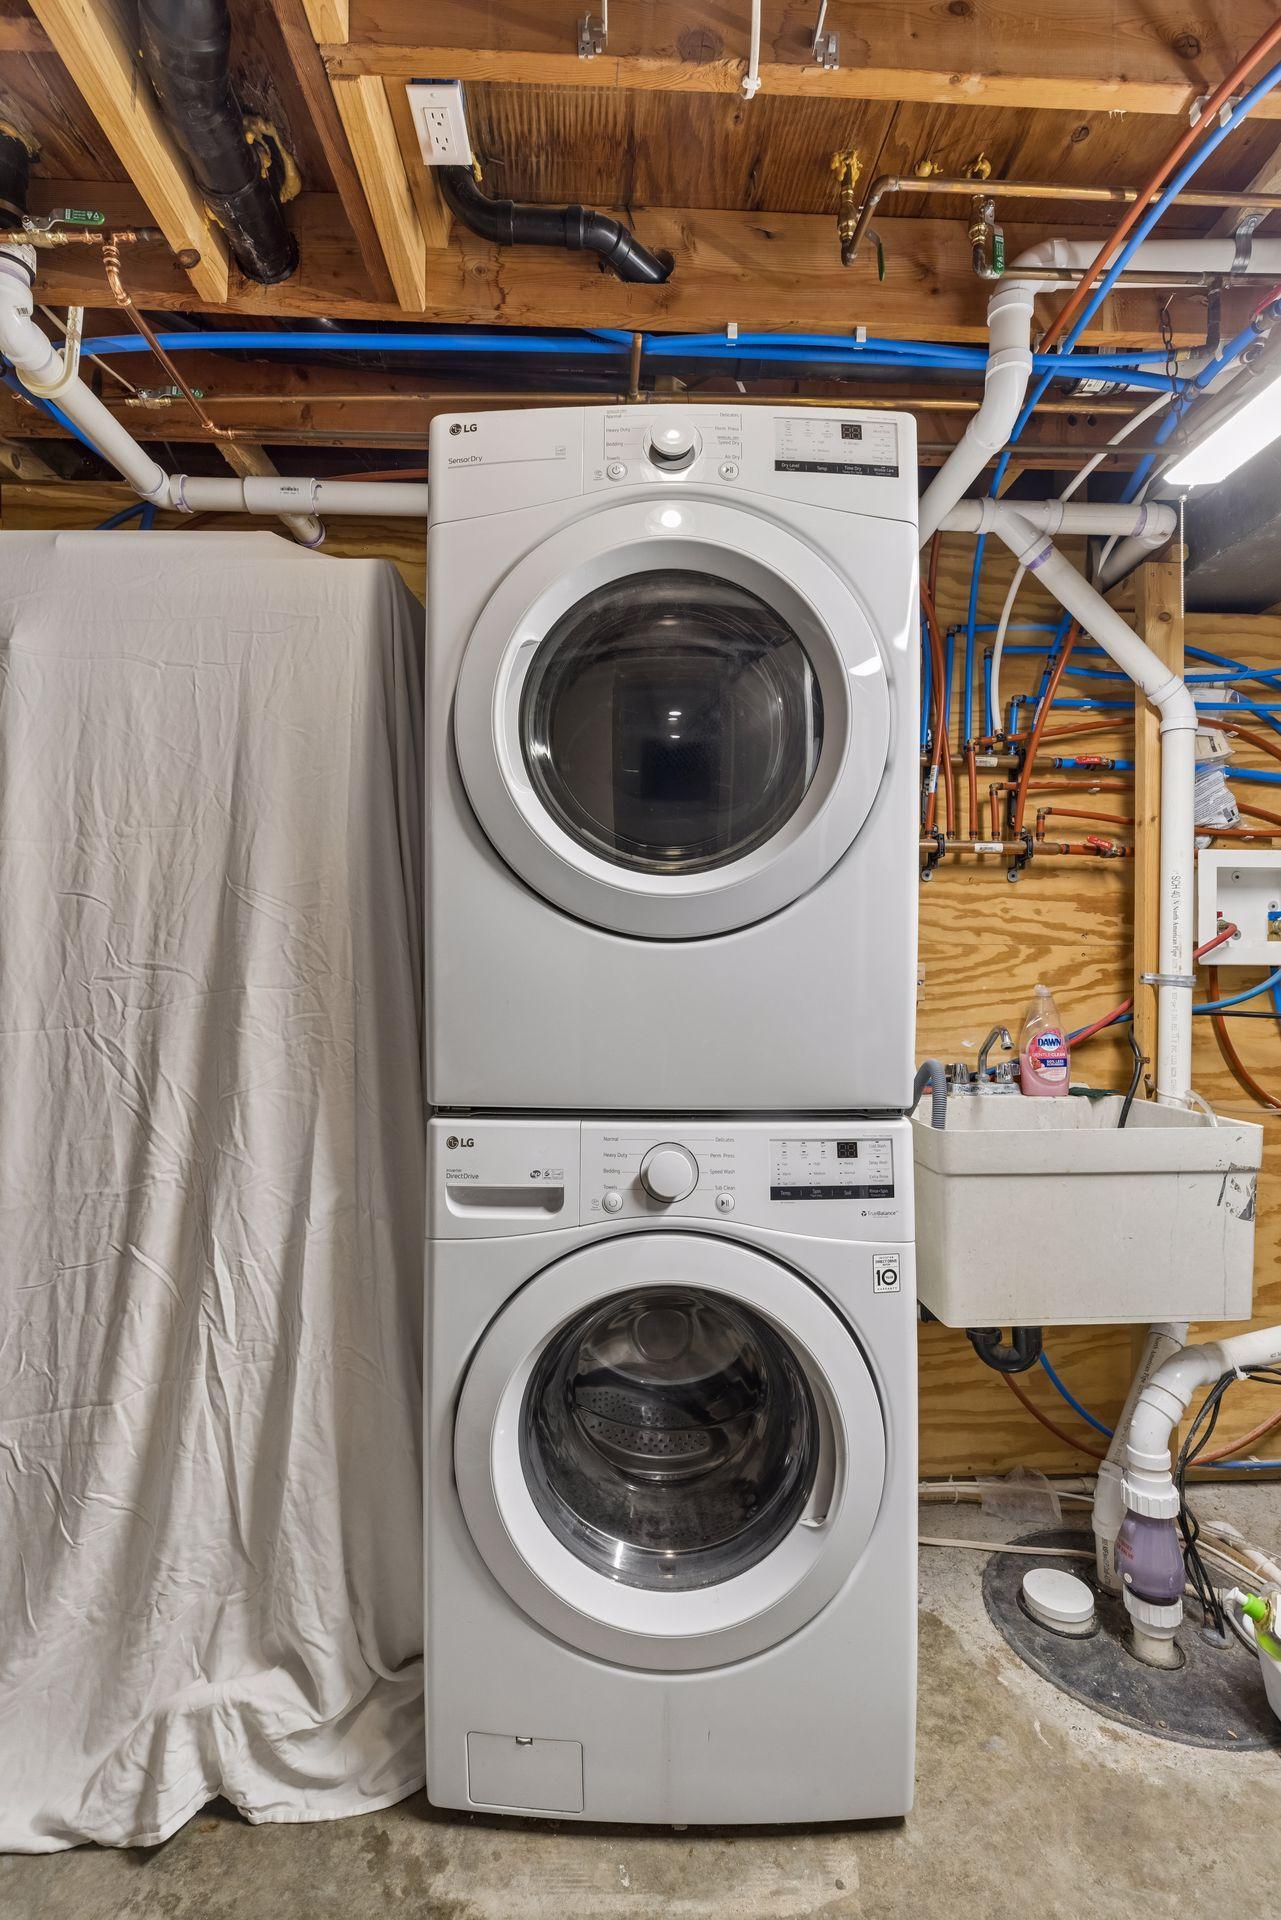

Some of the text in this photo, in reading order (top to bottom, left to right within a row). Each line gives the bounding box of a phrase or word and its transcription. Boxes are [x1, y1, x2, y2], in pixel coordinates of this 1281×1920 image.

[463, 423, 478, 433] LG
[1171, 875, 1181, 889] SCH
[1171, 890, 1181, 899] 40
[1172, 906, 1180, 921] North
[1172, 921, 1180, 945] American
[1038, 1038, 1061, 1046] DAWN
[460, 1137, 475, 1148] LG
[876, 1268, 898, 1286] 10
